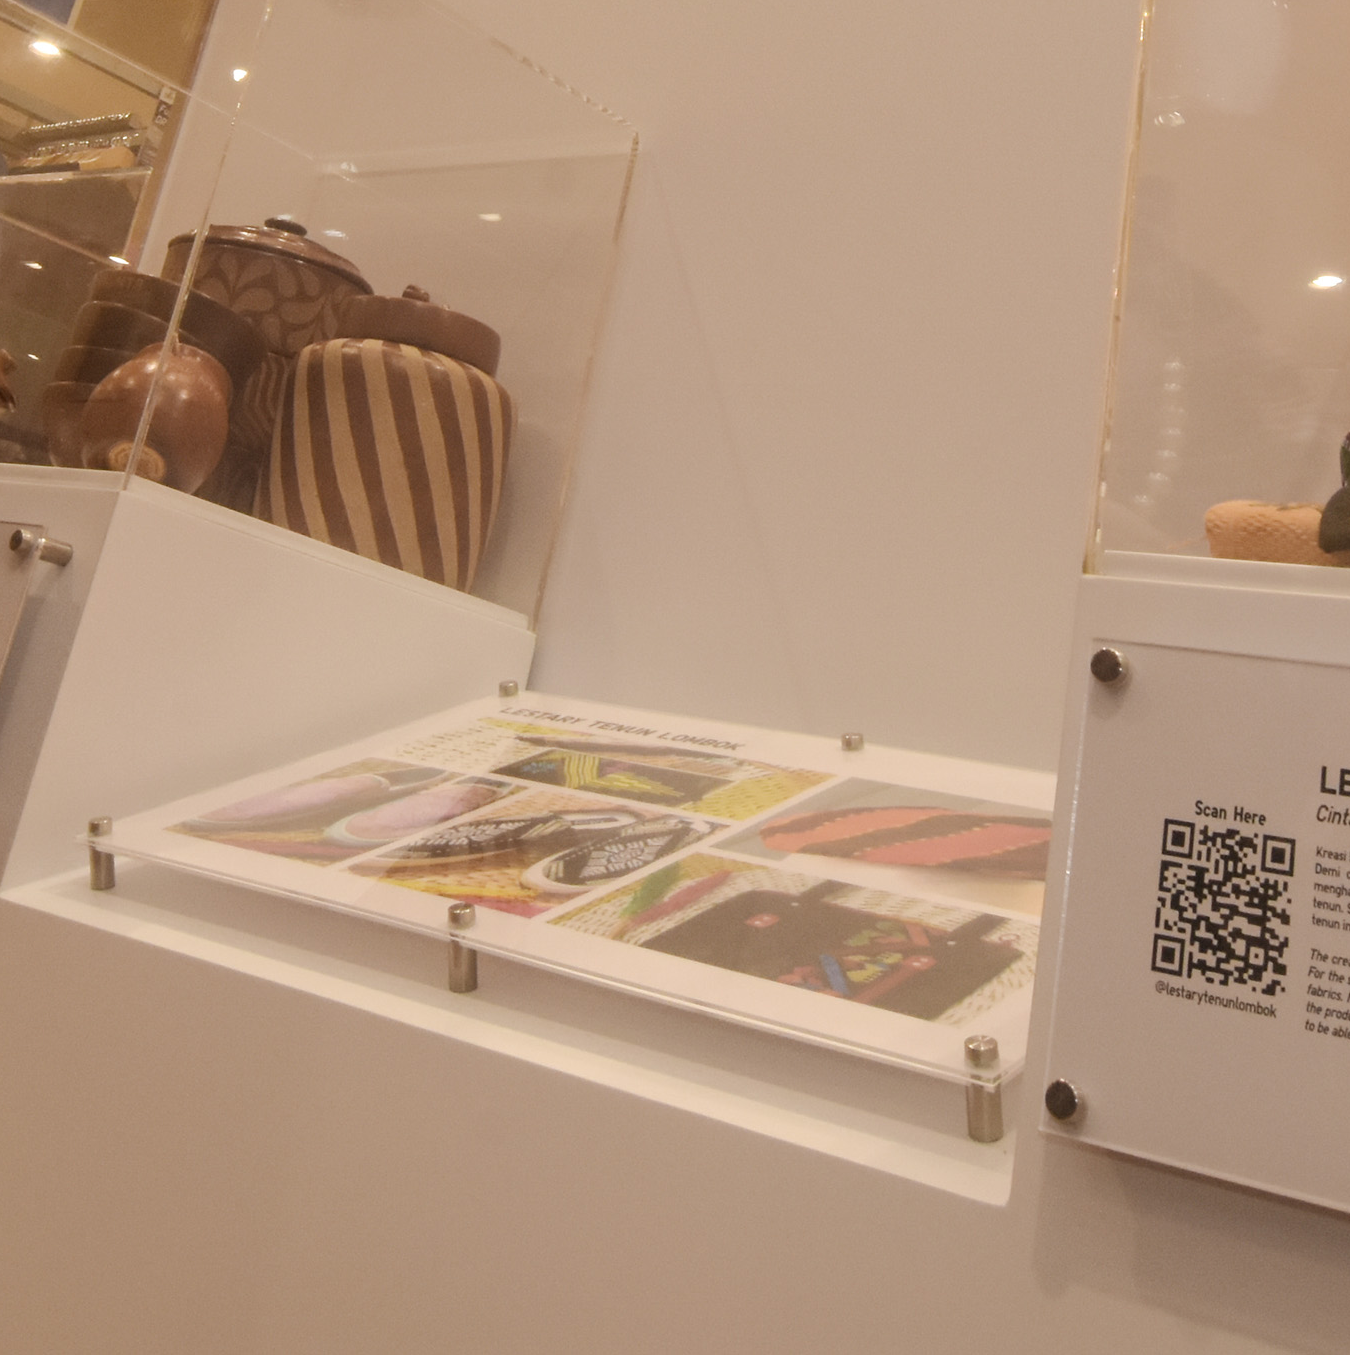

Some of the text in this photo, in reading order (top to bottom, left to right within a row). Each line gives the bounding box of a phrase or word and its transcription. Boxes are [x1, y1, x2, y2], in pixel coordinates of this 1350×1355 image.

[499, 706, 746, 751] LESTARY TENUN LOMBOK
[1194, 799, 1267, 826] Scan Here
[1315, 845, 1347, 862] Kreasi
[1314, 862, 1340, 877] Demi
[1155, 980, 1277, 1018] @lestarytenunlombok
